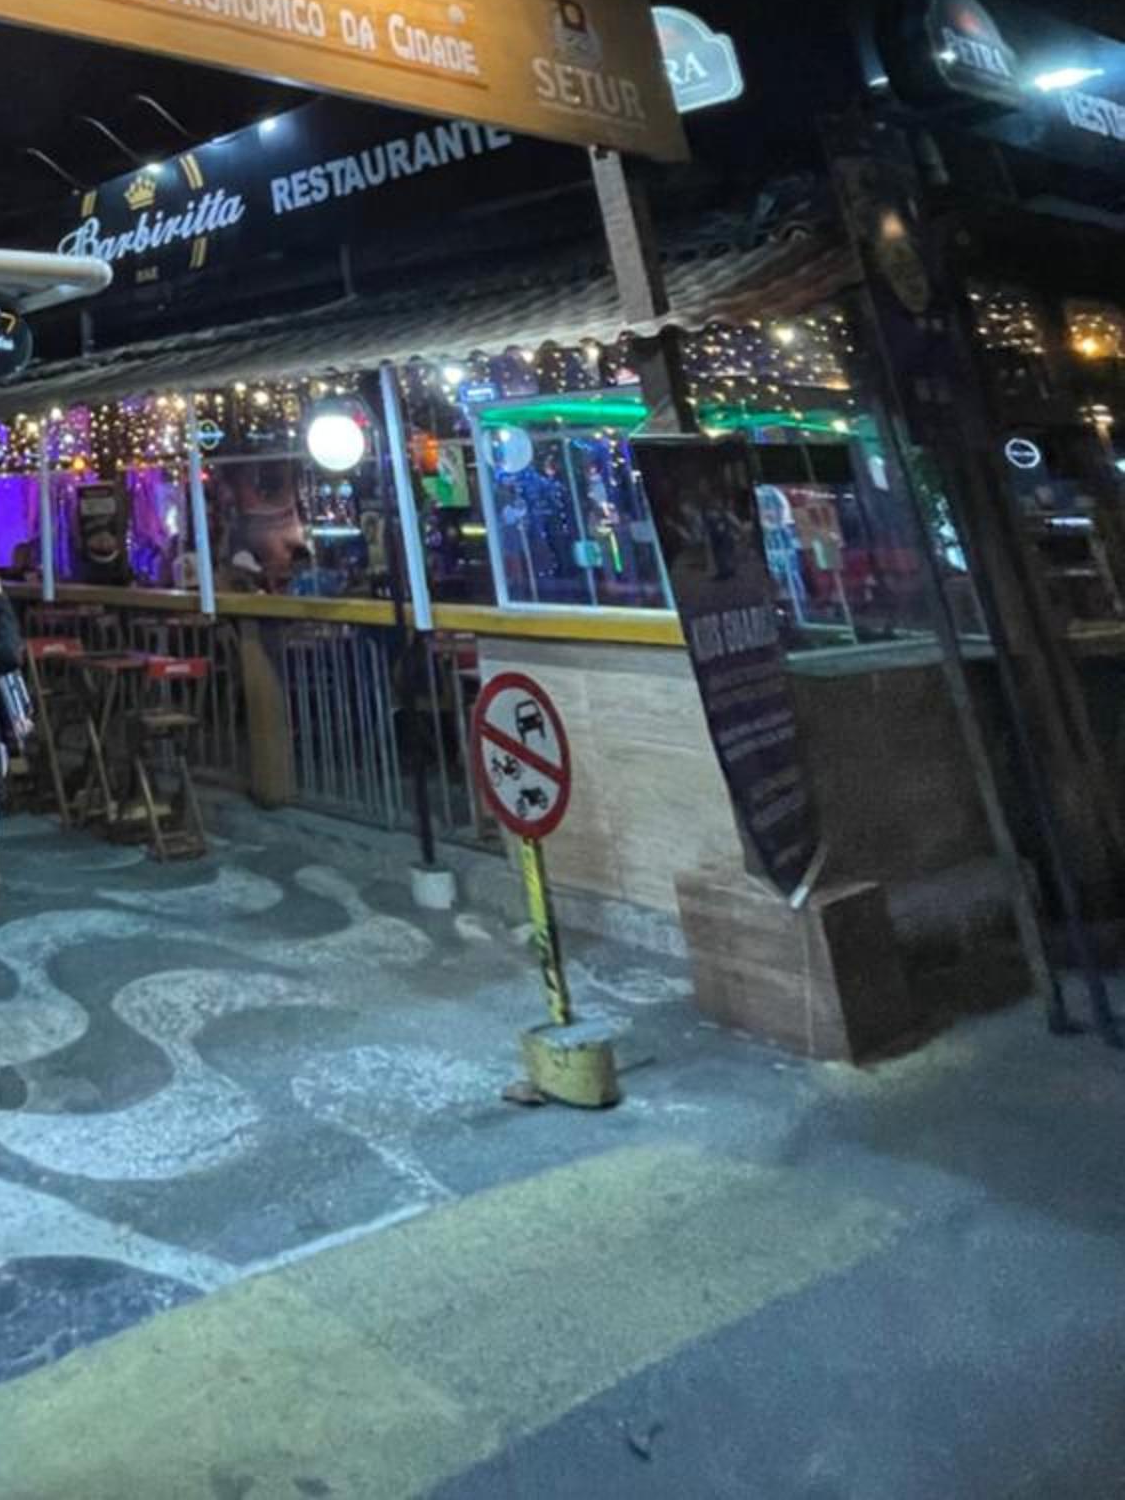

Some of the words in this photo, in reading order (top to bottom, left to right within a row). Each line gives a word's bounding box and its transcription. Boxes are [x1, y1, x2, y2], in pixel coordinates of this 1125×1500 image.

[339, 8, 376, 53] DA
[388, 13, 480, 76] CIDADE
[532, 56, 647, 120] SETUR
[270, 120, 512, 215] RESTAURANTE
